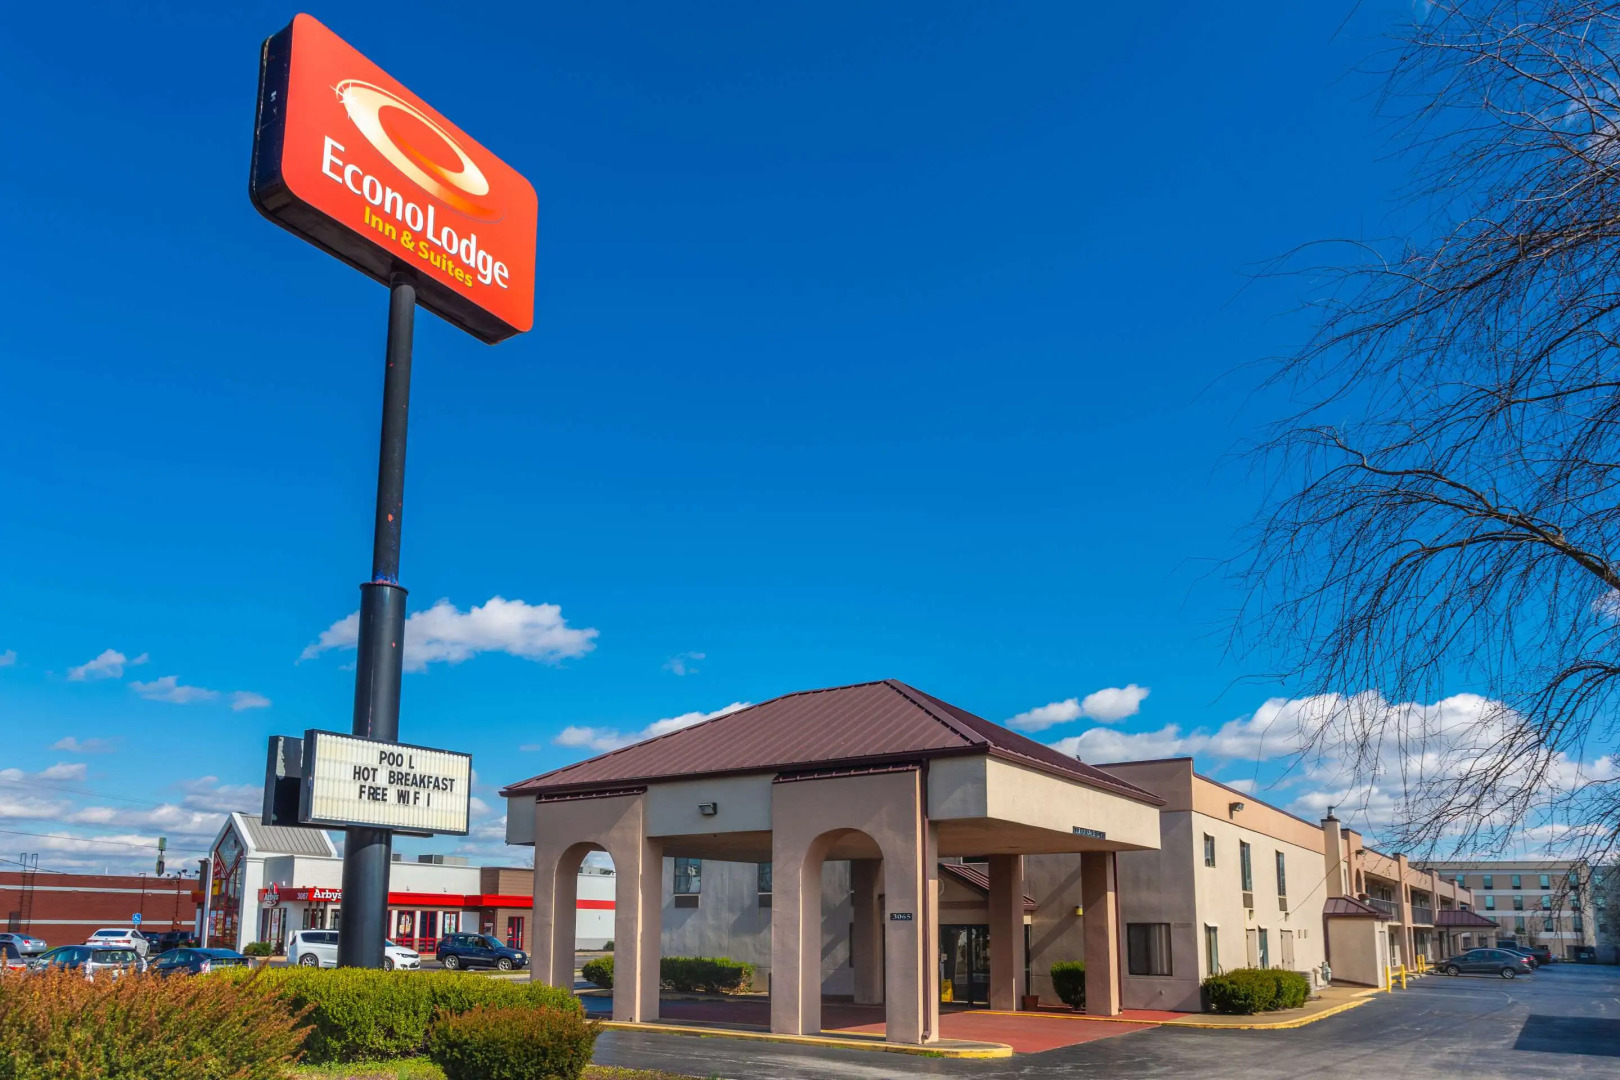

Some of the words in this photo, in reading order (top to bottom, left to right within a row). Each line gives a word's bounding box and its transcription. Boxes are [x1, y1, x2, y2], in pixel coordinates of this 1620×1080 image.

[322, 135, 509, 288] EconoLodge
[364, 205, 397, 240] Inn
[400, 230, 415, 252] &
[418, 241, 473, 287] Suites
[379, 751, 415, 769] POOL
[353, 765, 378, 782] HOT
[388, 771, 455, 792] BREAKFAST
[359, 784, 388, 802] FREE
[313, 889, 342, 902] Arby's
